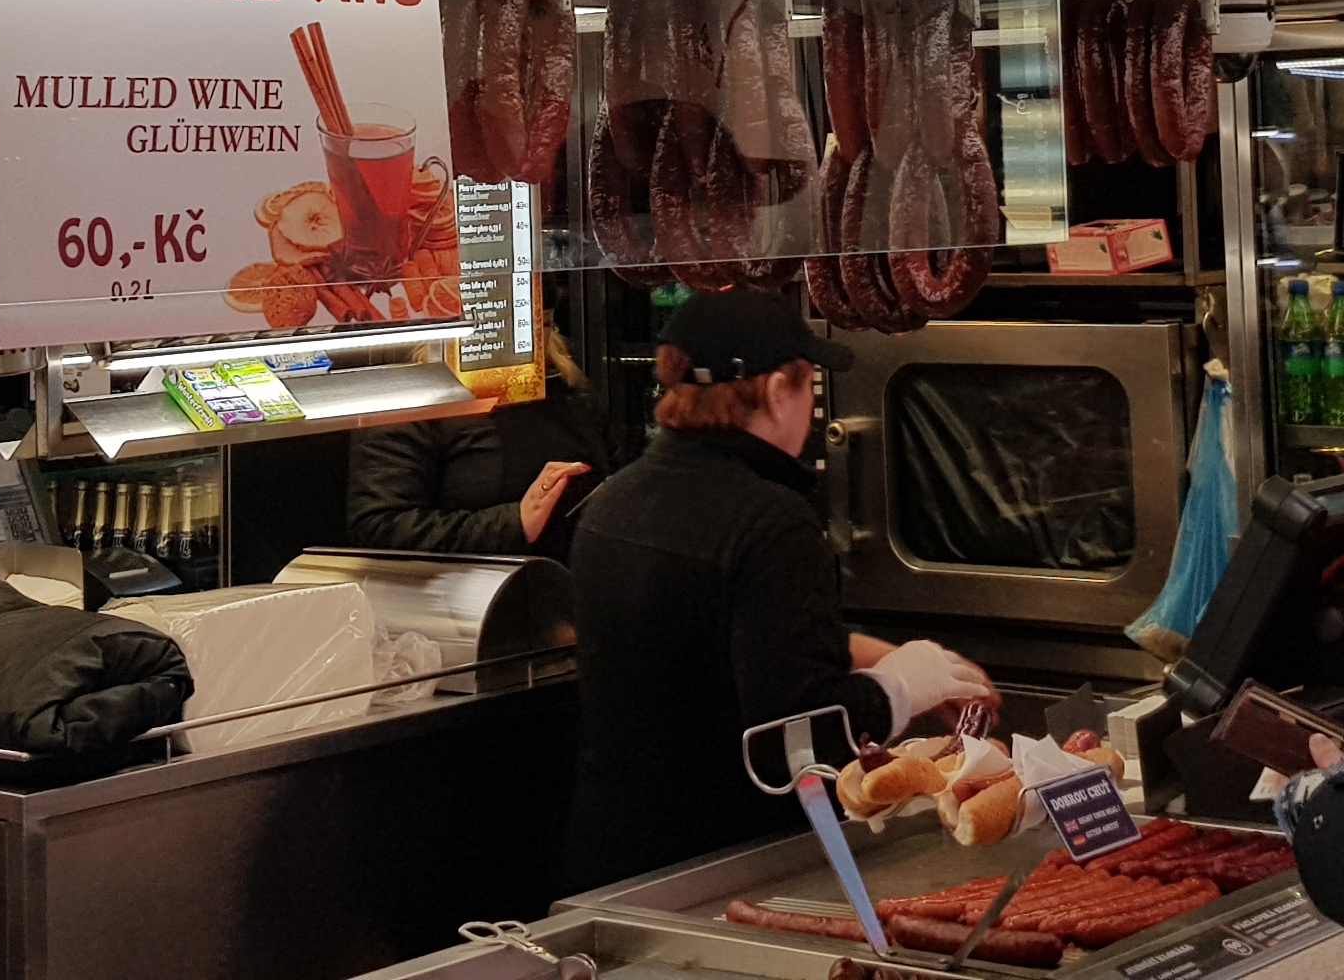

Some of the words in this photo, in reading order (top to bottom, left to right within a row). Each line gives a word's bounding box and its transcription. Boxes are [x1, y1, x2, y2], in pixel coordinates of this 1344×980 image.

[14, 73, 177, 111] MULLED
[187, 77, 284, 111] WINE
[125, 118, 301, 154] GLÜHWEIN
[177, 381, 214, 427] Winterfresh
[1050, 789, 1088, 811] DOBROU
